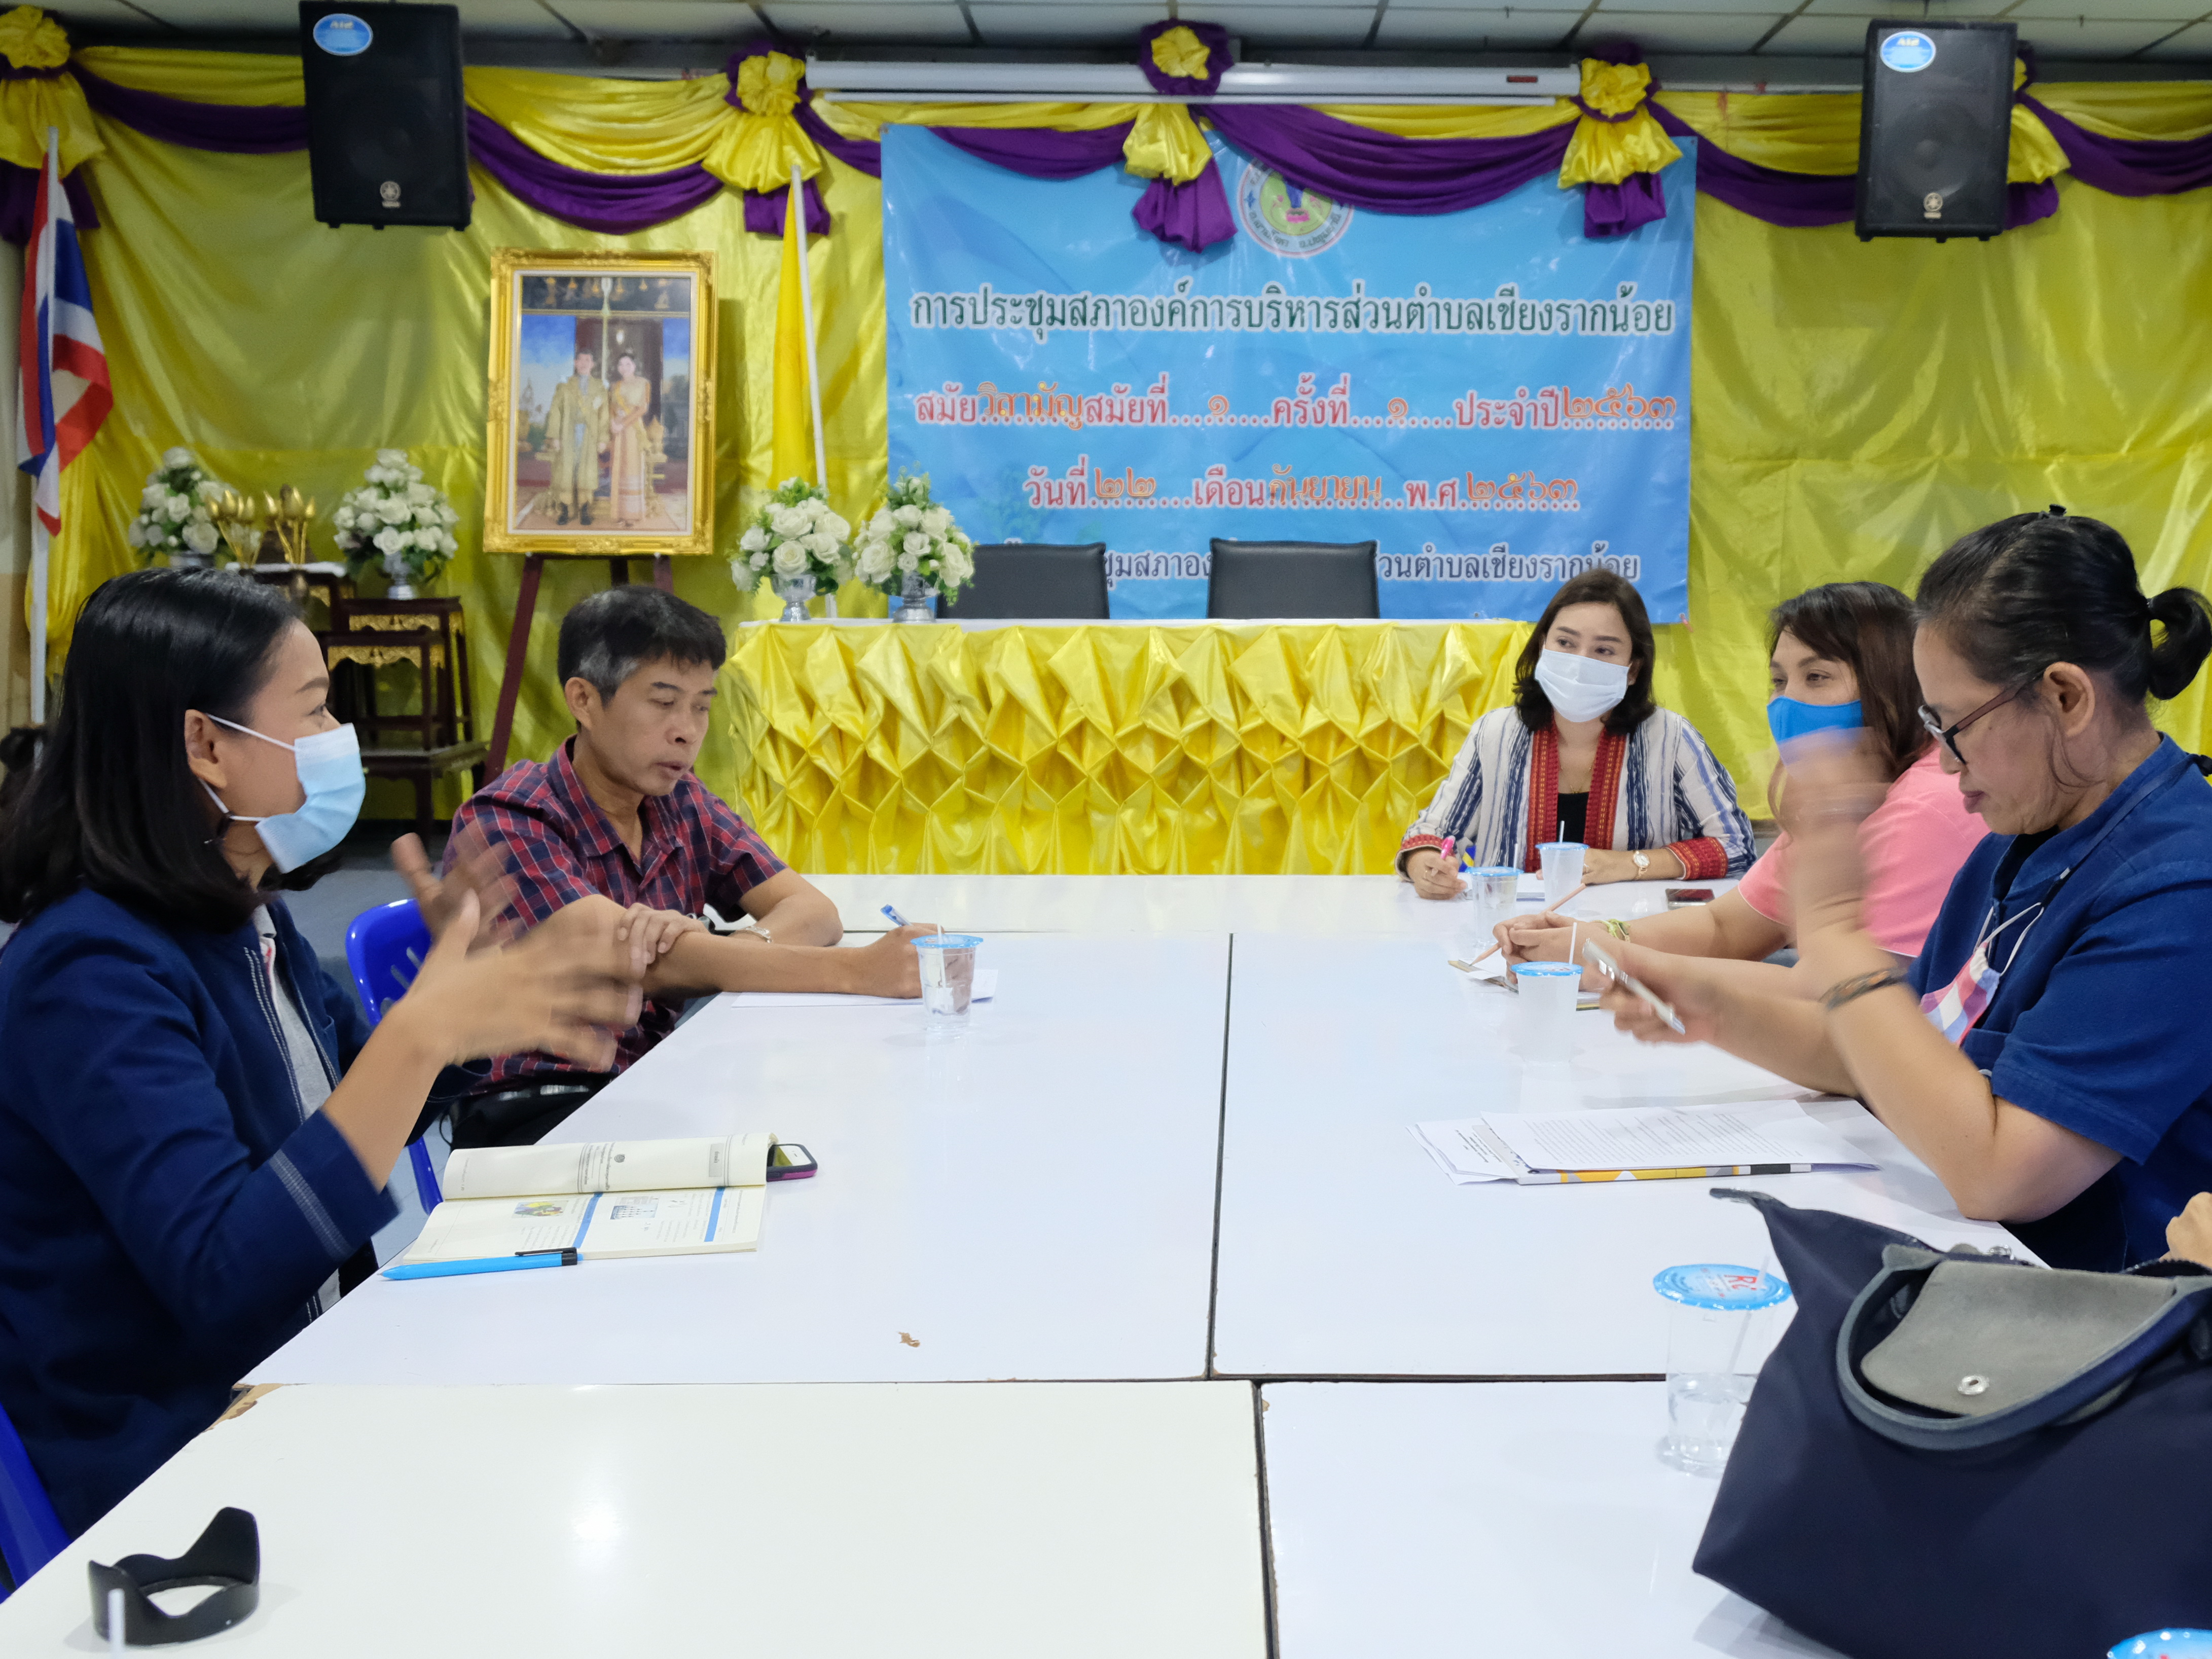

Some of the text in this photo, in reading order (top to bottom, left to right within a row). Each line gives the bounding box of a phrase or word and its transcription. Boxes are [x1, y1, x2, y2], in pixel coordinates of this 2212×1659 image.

[913, 279, 1674, 341] การประชุมสภาองค์การบริหารส่วนตำบลเชียงรากน้อย
